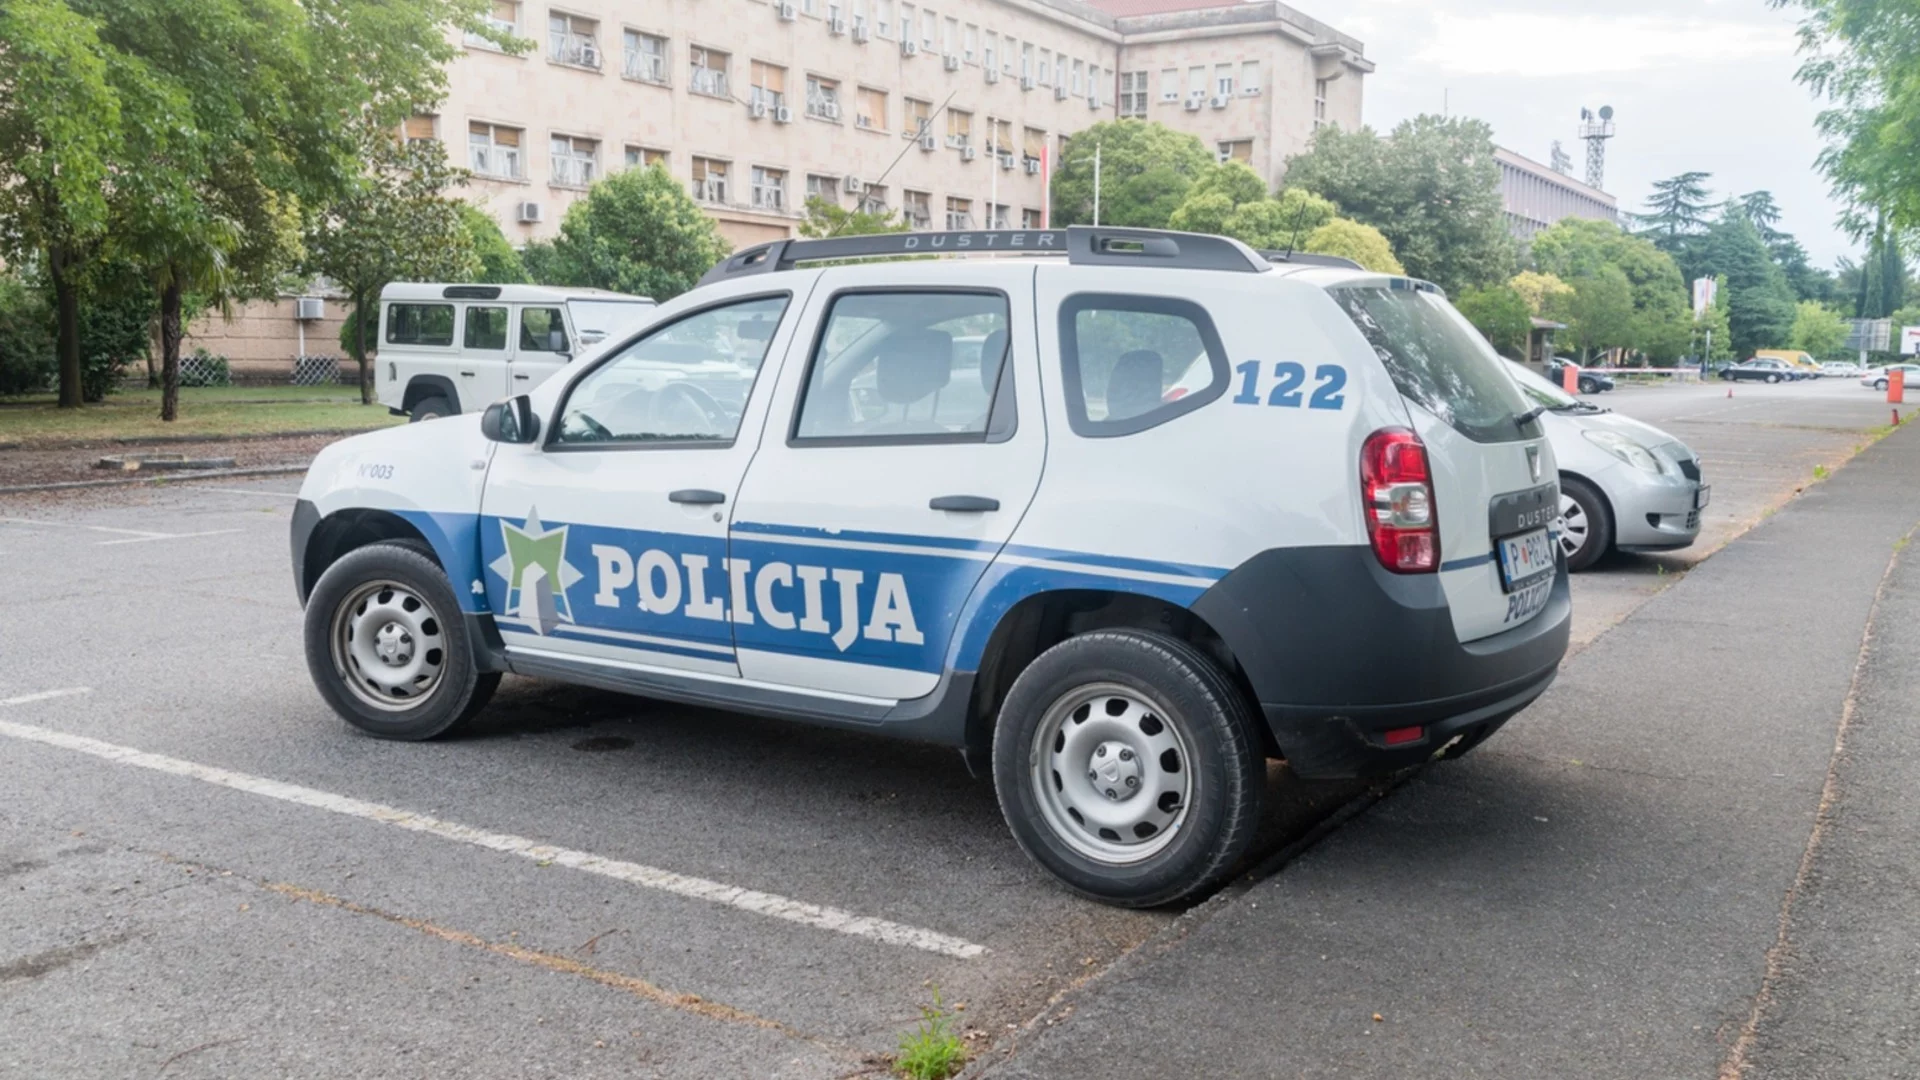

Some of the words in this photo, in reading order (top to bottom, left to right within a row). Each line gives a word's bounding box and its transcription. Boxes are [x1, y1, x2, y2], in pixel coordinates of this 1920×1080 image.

[904, 233, 1055, 249] DUSTER
[1232, 359, 1348, 411] 122
[1518, 505, 1555, 529] DUSTER
[591, 543, 924, 652] POLICIJA
